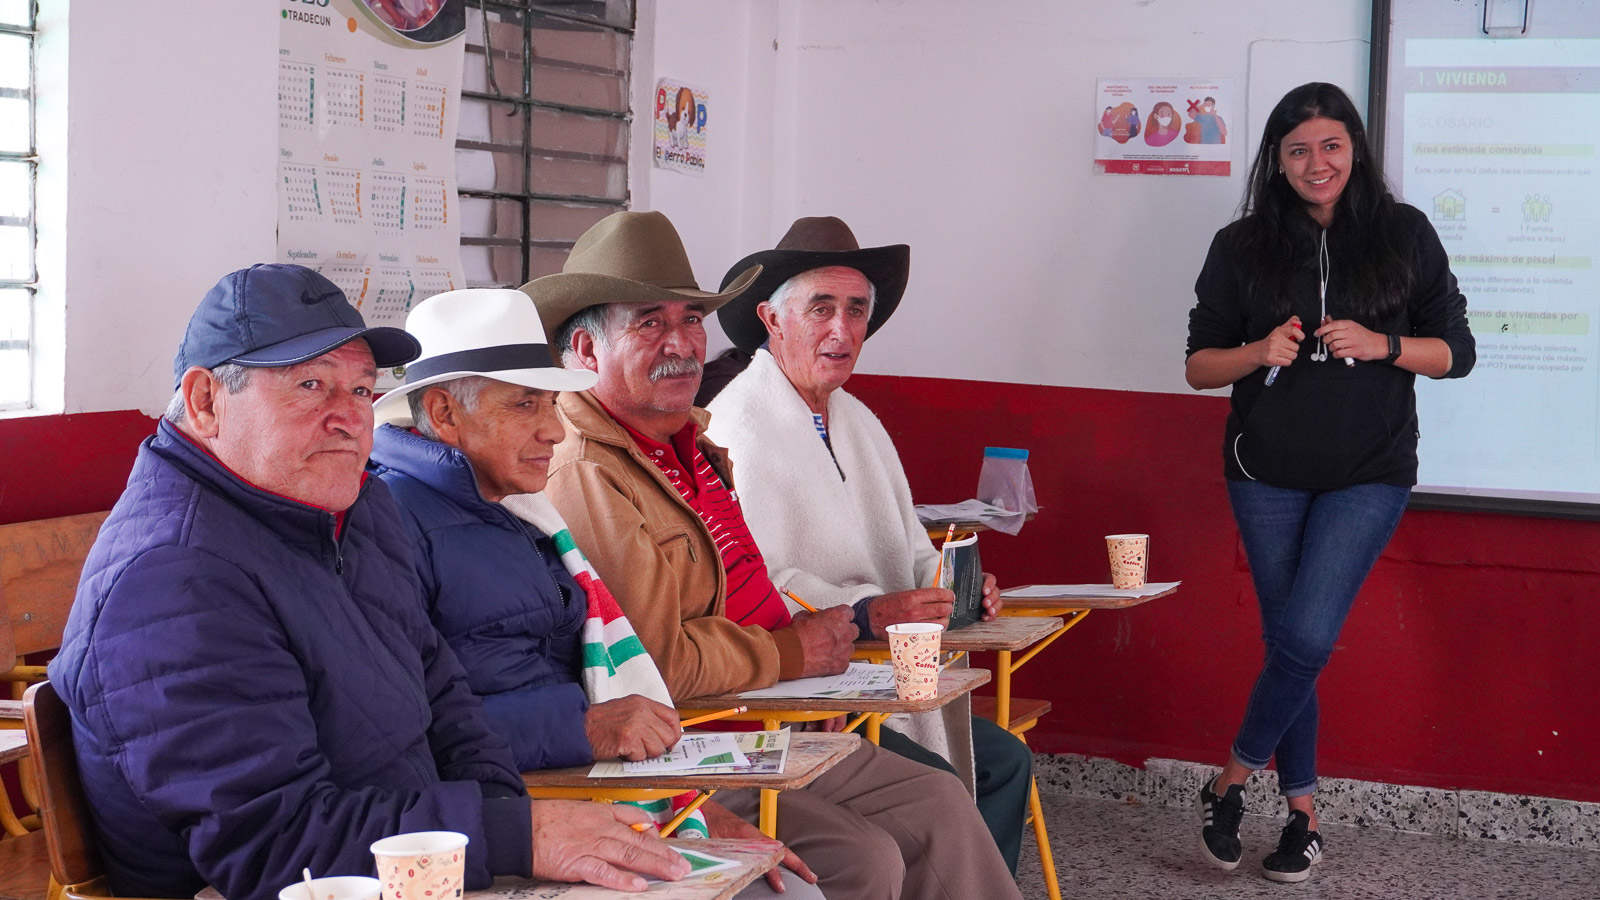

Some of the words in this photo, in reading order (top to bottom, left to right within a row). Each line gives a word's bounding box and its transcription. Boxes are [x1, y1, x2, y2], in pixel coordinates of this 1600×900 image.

[288, 9, 331, 26] TRADECUN
[1418, 72, 1431, 86] 1.
[1435, 71, 1508, 86] VIVIENDA
[1416, 115, 1494, 129] GLOSARIO
[1415, 143, 1439, 154] Área
[1441, 144, 1486, 154] estimada
[1489, 144, 1543, 155] construida
[1433, 167, 1451, 175] valor
[1465, 167, 1477, 175] m2
[1478, 167, 1498, 175] debe
[1501, 167, 1522, 175] darse
[1523, 167, 1575, 176] considerando
[1506, 235, 1536, 243] (padres
[1544, 235, 1566, 243] hijos)
[1454, 254, 1467, 263] de
[1469, 254, 1508, 264] máximo
[1511, 255, 1523, 264] de
[1526, 255, 1553, 266] pisos
[1487, 276, 1524, 284] diferentes
[1533, 276, 1540, 284] la
[1542, 276, 1573, 285] vivienda
[1494, 309, 1507, 318] de
[1509, 310, 1558, 320] viviendas
[1560, 312, 1579, 321] por
[1542, 354, 1555, 362] (de
[1556, 354, 1588, 362] máximo
[1486, 362, 1508, 370] POT)
[1508, 362, 1535, 370] estaría
[1536, 364, 1570, 372] ocupada
[1571, 365, 1584, 373] por
